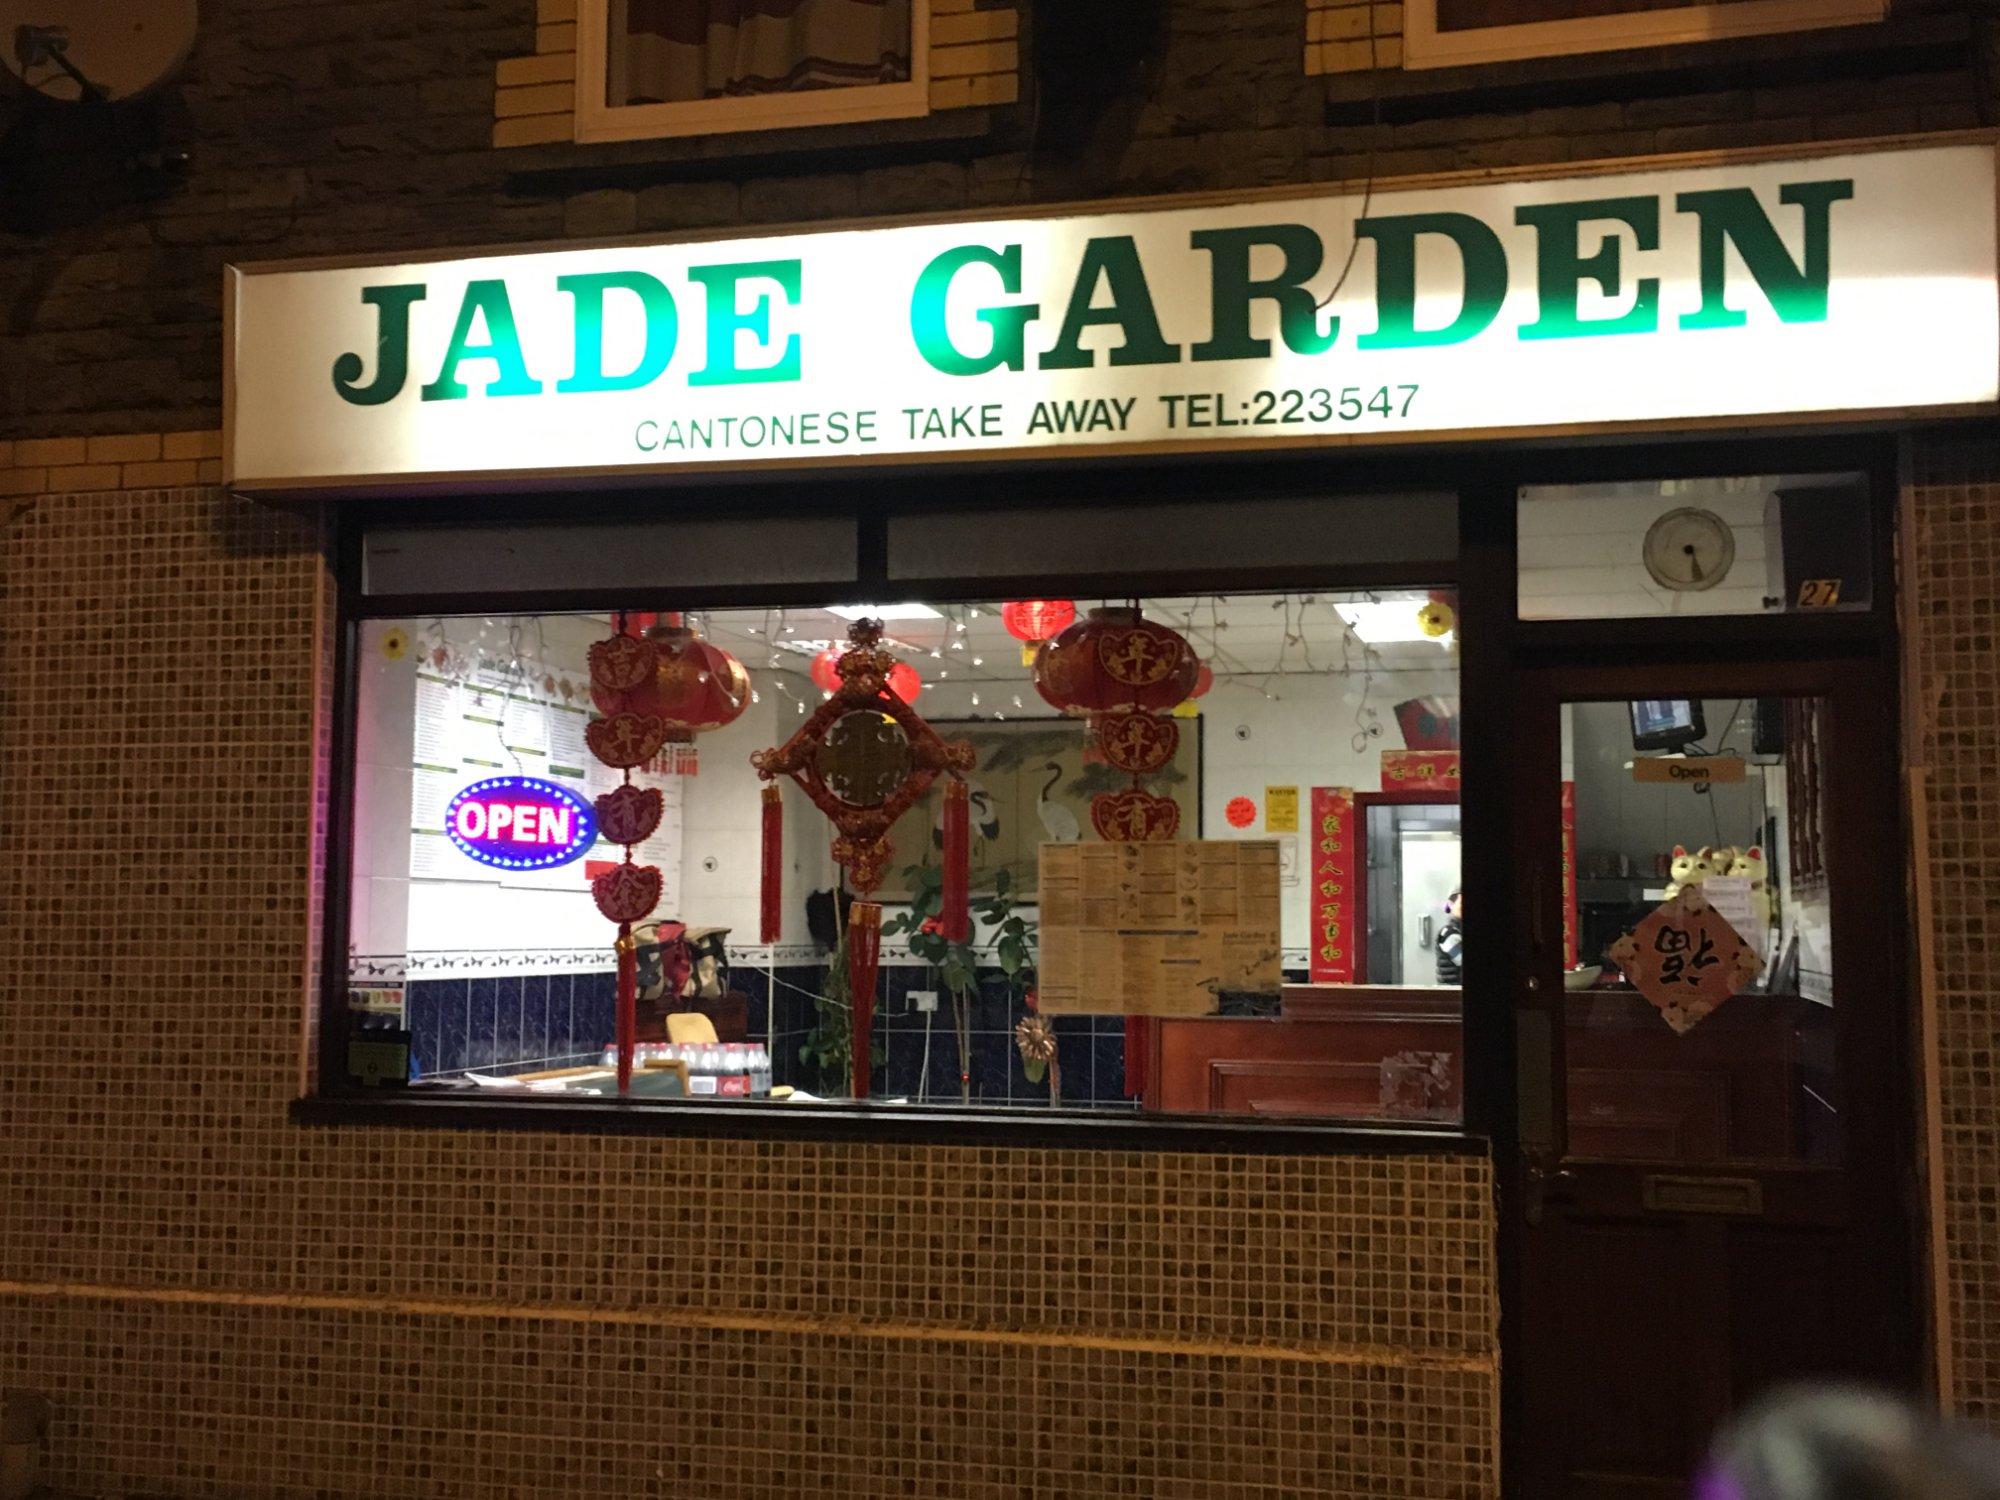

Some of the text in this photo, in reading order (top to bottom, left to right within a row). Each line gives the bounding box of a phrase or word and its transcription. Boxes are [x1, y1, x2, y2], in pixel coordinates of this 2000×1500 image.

[332, 178, 1854, 406] JADE GARDEN
[634, 384, 1420, 452] CANTONESE TAKE AWAY TEL:223547
[1800, 582, 1836, 606] 27
[1668, 764, 1709, 780] Open
[456, 801, 570, 844] OPEN
[1654, 924, 1720, 986] 福
